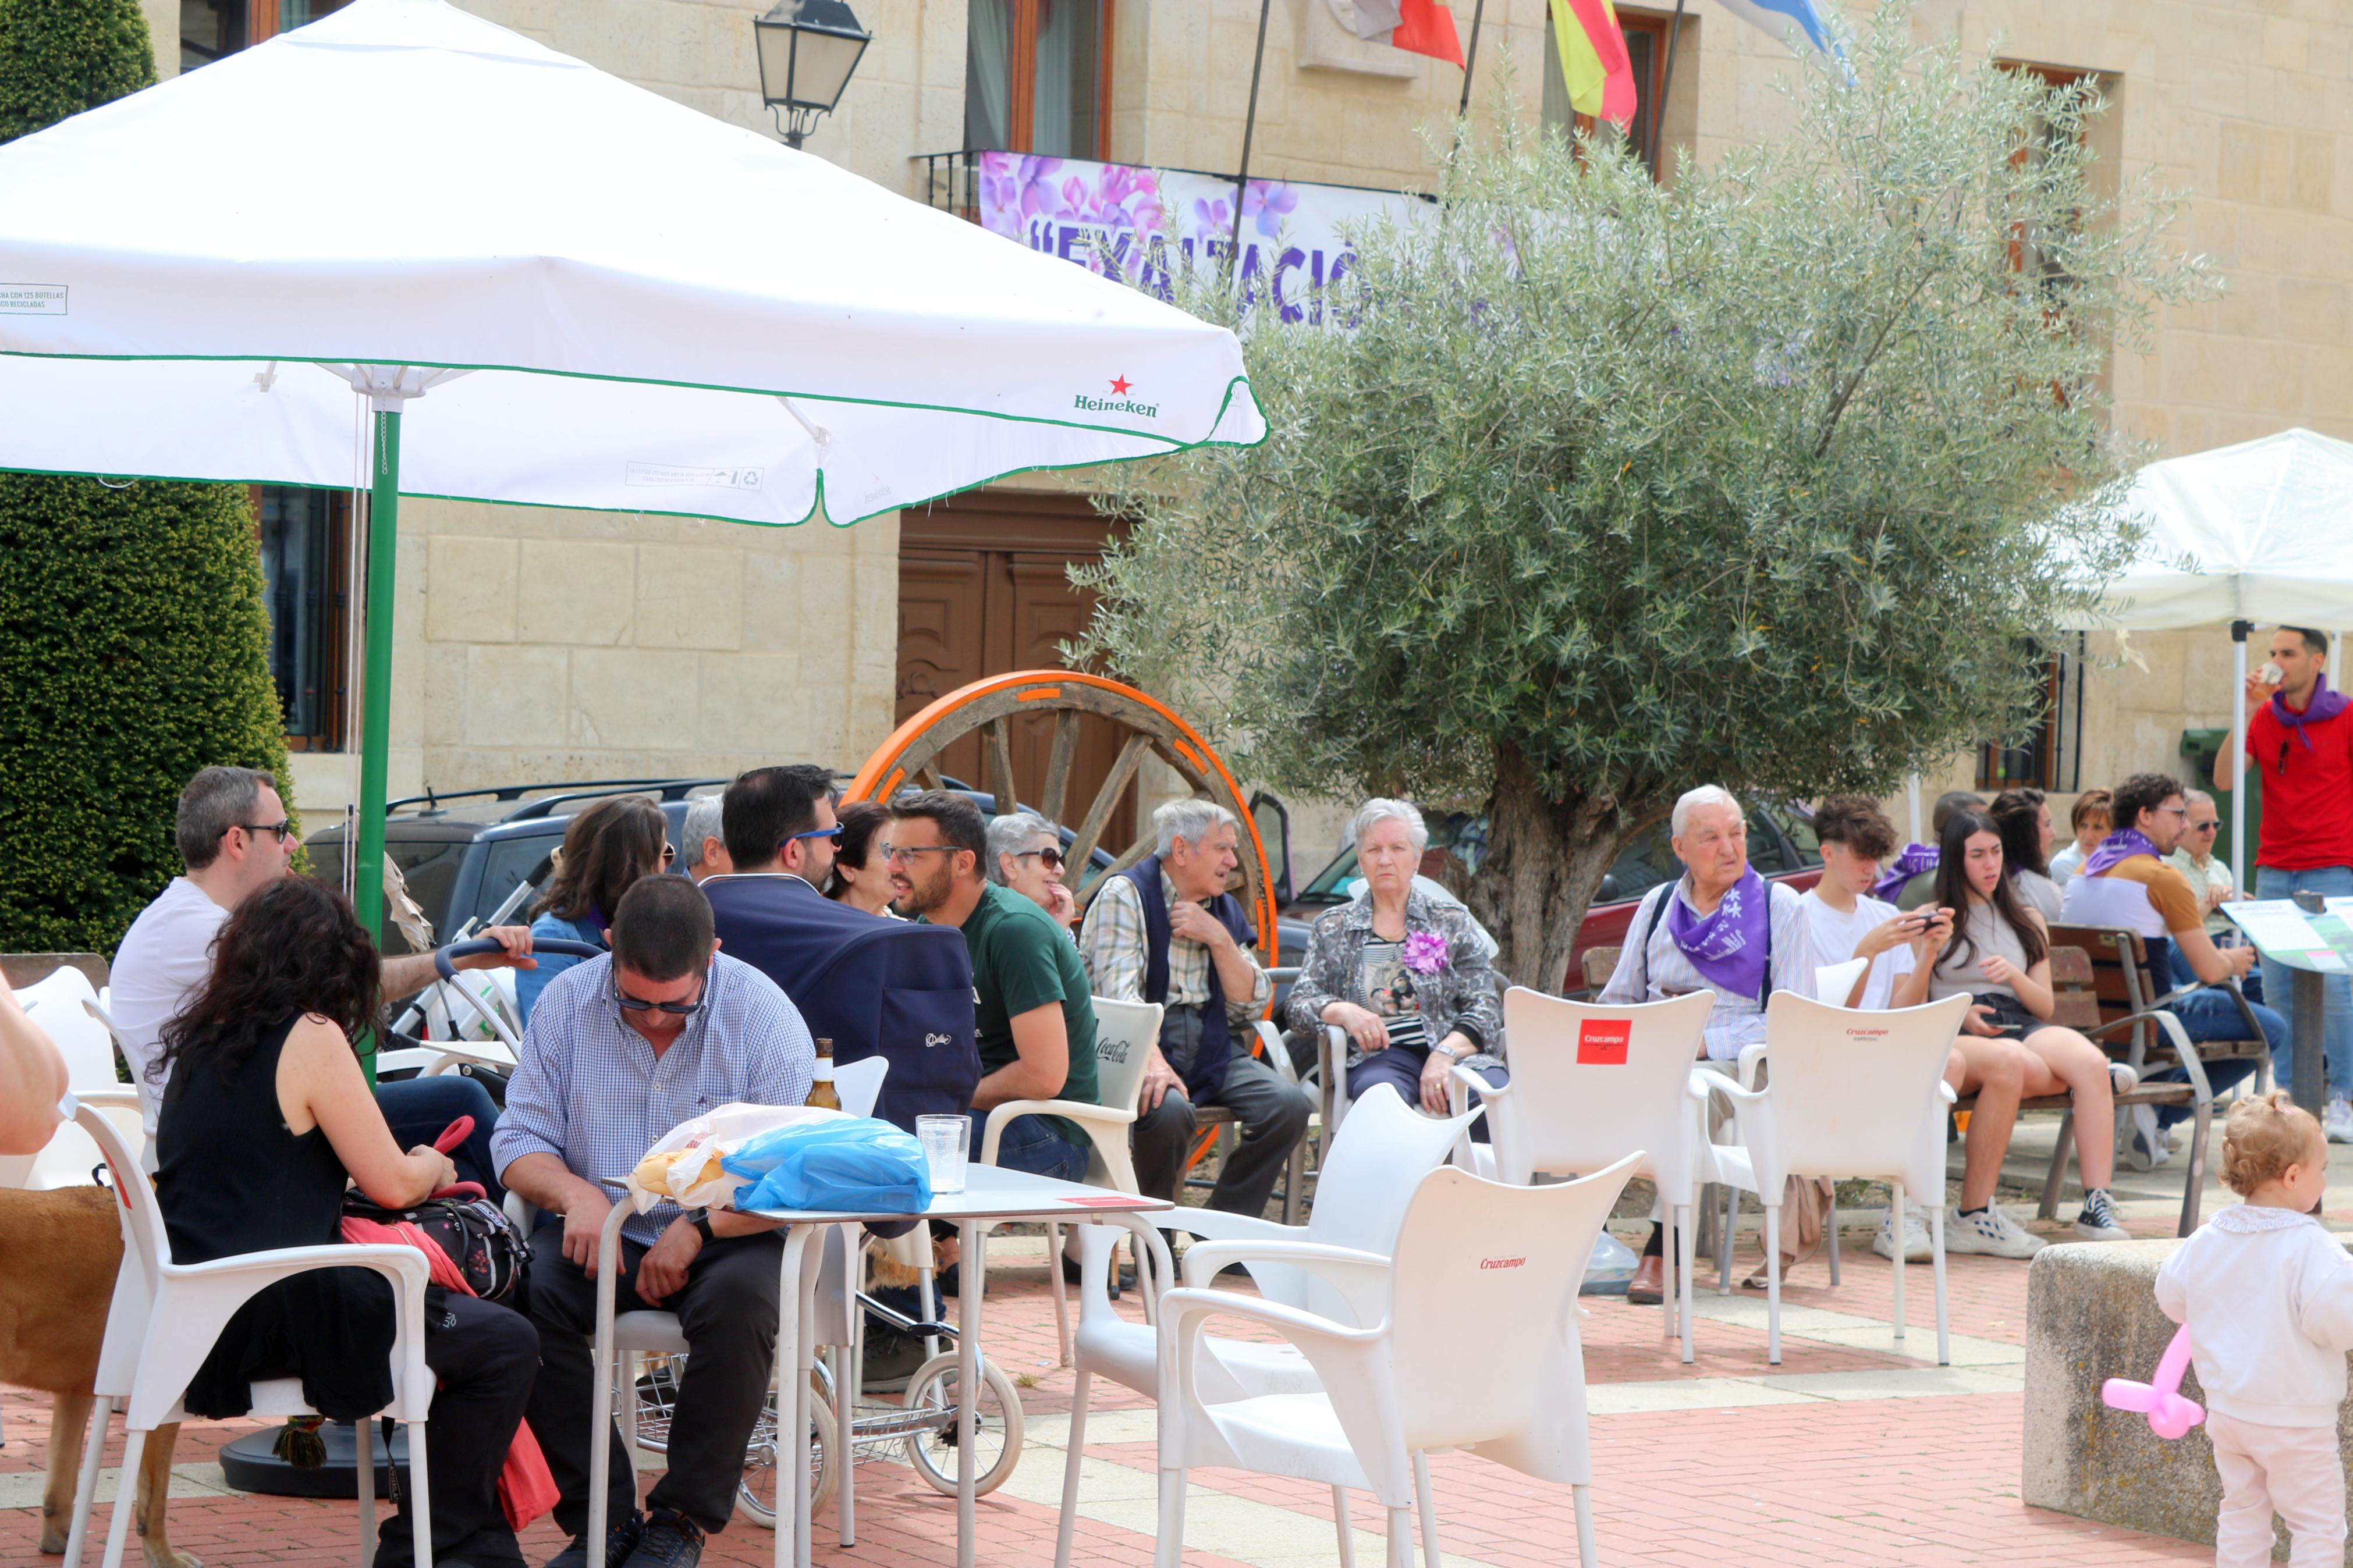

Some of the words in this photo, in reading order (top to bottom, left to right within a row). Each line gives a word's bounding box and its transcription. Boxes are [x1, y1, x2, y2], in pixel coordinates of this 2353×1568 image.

[1074, 394, 1158, 418] Heineken
[1846, 1028, 1889, 1036] Cruzcampo
[1584, 1034, 1624, 1044] Cruzcampo
[1480, 1257, 1527, 1270] Cruzcampo
